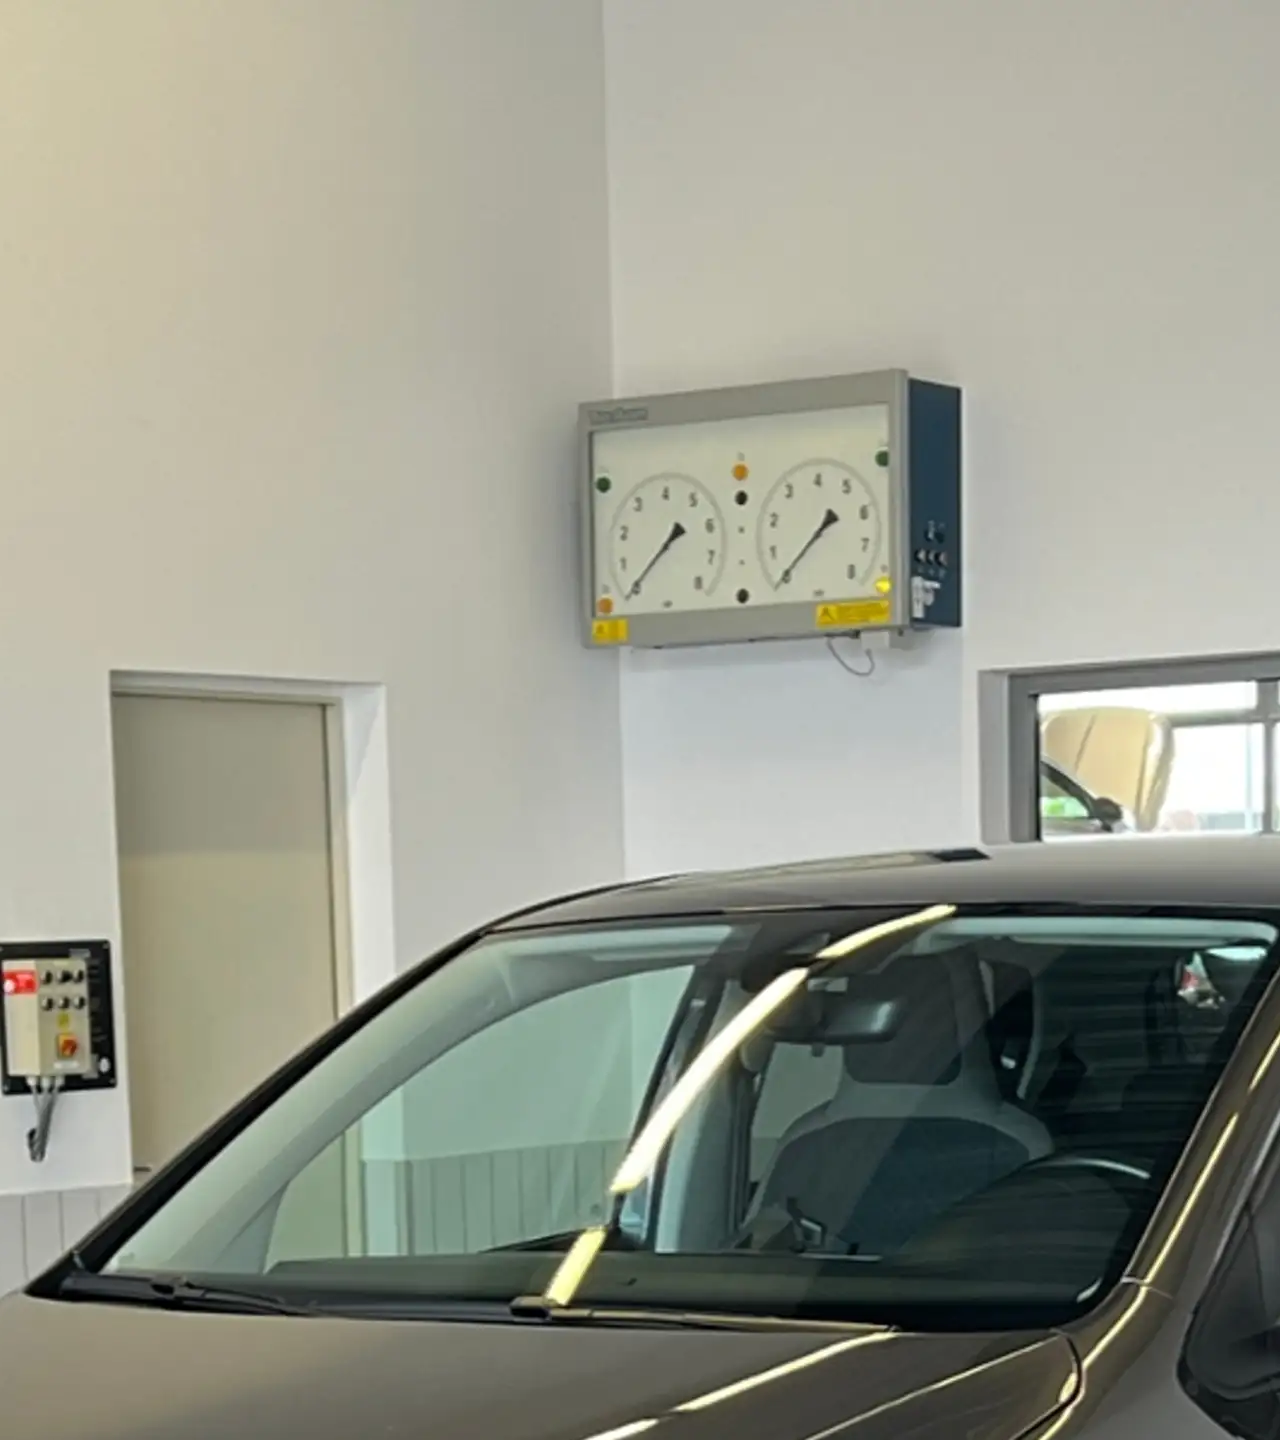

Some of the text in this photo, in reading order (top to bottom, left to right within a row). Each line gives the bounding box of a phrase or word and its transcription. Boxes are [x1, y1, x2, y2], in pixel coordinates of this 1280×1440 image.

[814, 473, 822, 487] 4
[842, 477, 851, 495] 5
[662, 486, 669, 500] 4
[785, 483, 793, 498] 3
[633, 497, 642, 512] 3
[689, 492, 698, 507] 5
[860, 504, 869, 520] 6
[705, 518, 715, 533] 6
[770, 512, 779, 528] 2
[620, 525, 628, 541] 2
[770, 545, 777, 559] 1
[861, 537, 869, 552] 7
[620, 557, 627, 572] 1
[707, 550, 715, 565] 7
